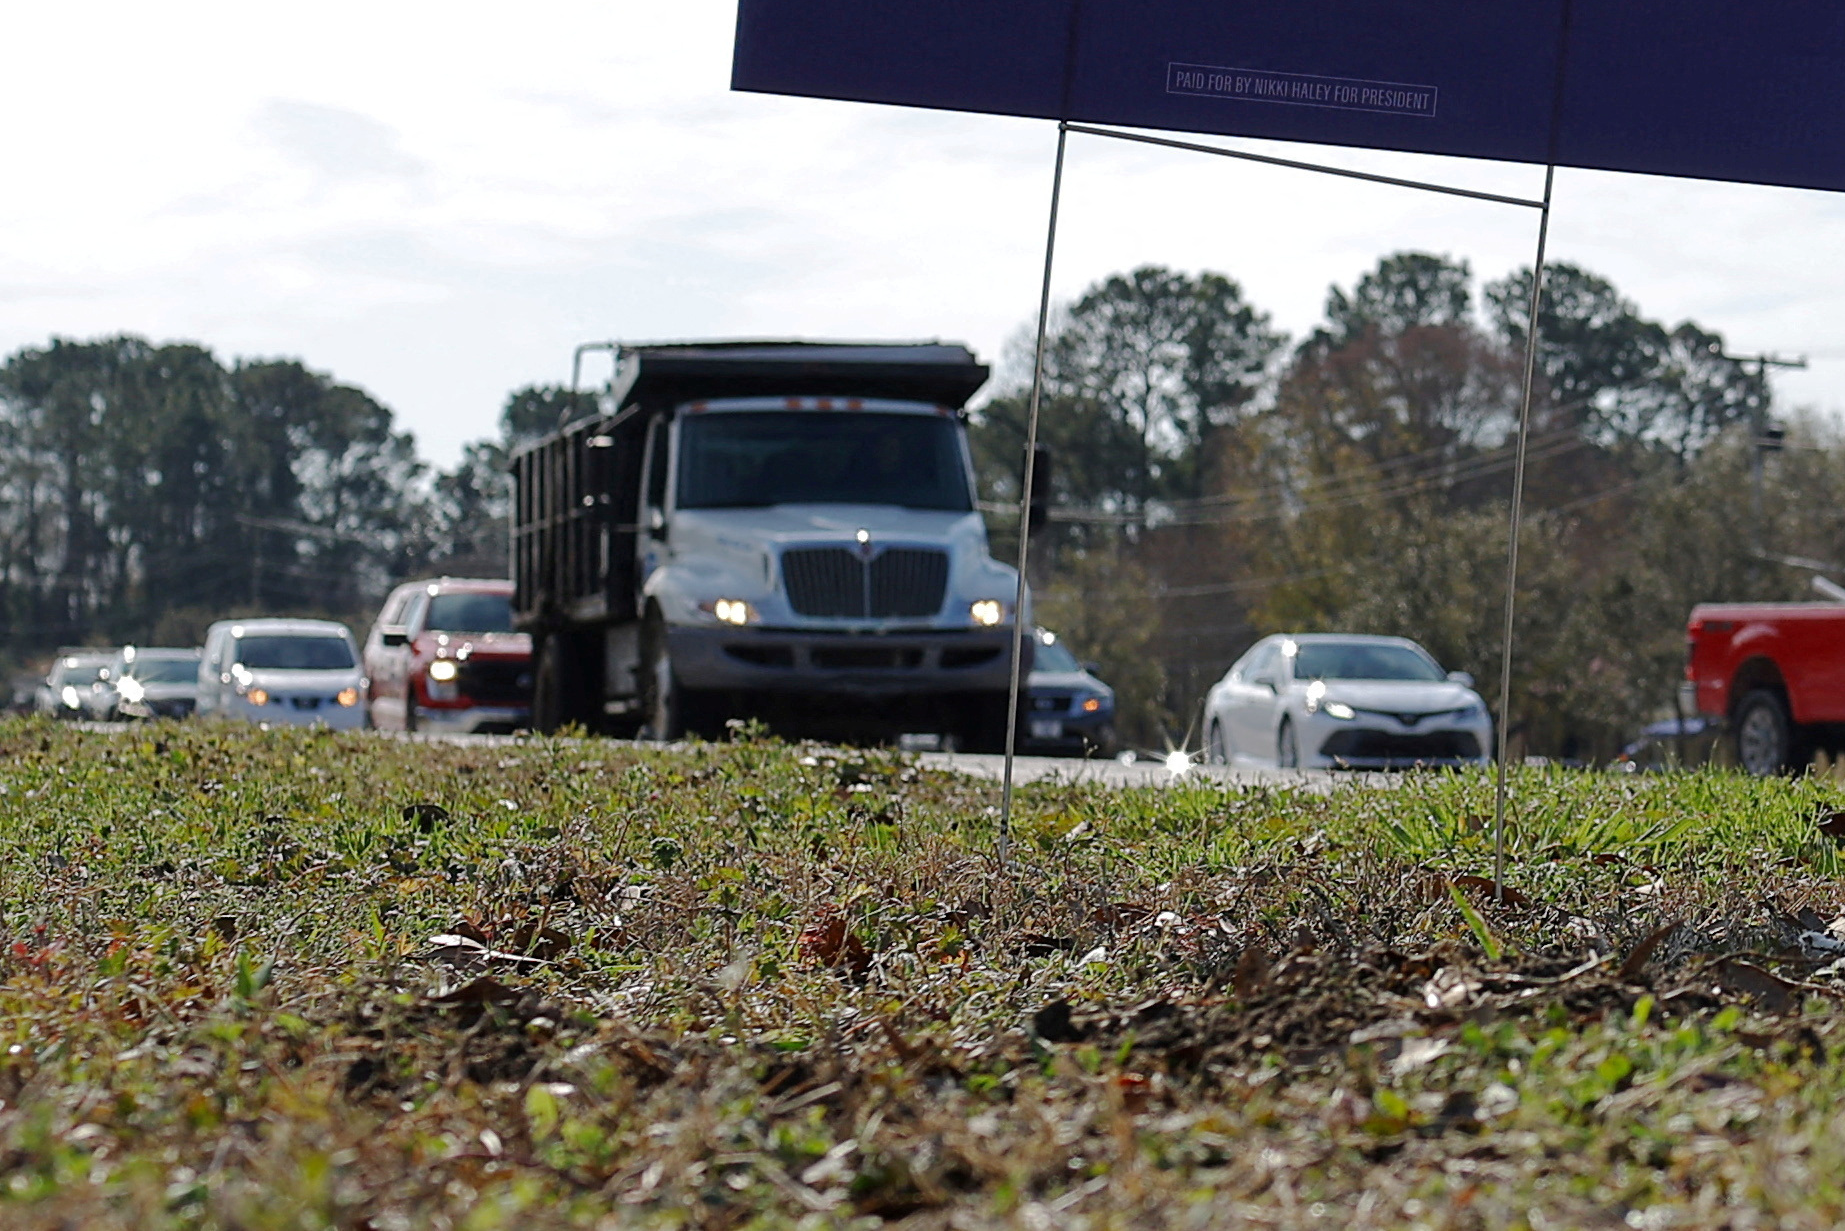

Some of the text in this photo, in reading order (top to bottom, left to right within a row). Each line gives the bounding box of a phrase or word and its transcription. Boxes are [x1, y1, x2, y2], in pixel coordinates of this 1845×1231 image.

[1176, 71, 1430, 110] PAID FOR BY NIKKI HALEY FOR PRESIDENT
